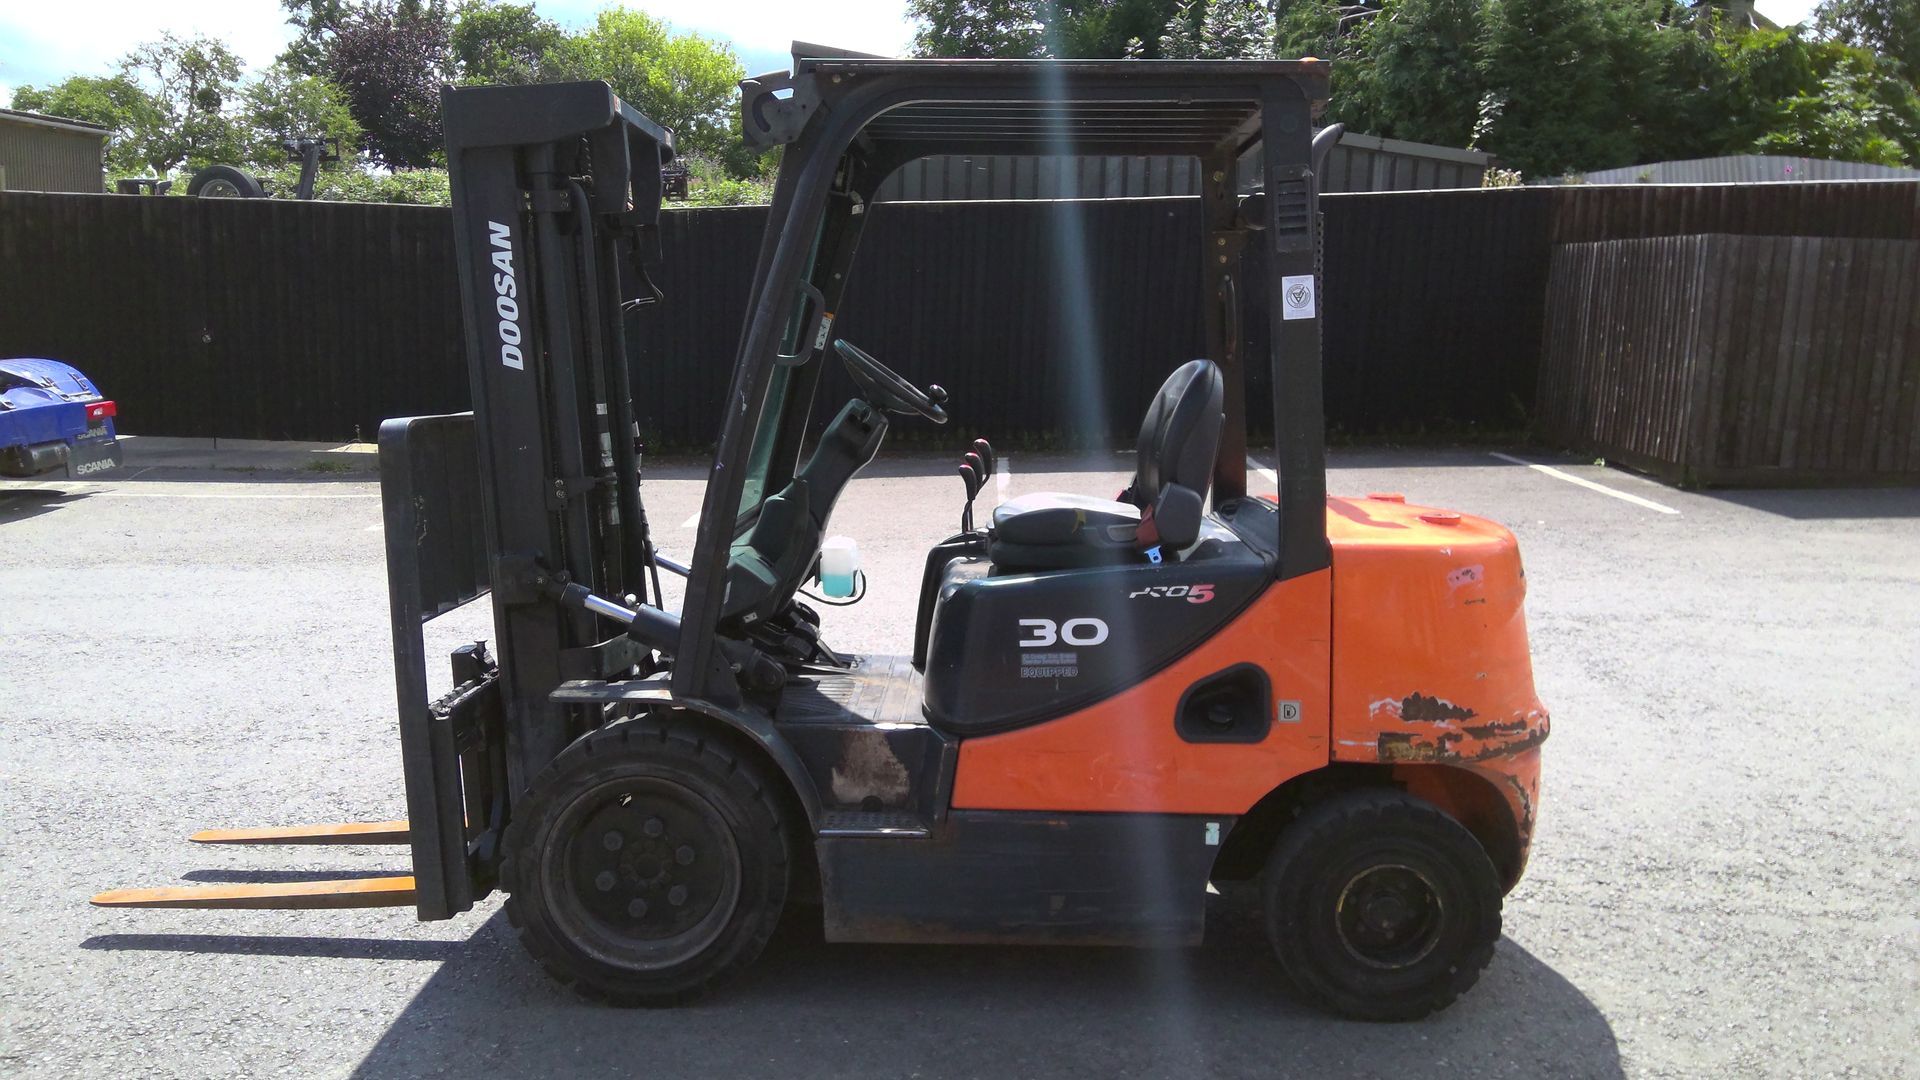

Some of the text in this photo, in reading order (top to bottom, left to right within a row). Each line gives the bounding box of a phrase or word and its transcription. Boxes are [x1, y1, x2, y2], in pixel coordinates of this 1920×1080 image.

[488, 220, 524, 371] DOOSAN
[77, 458, 116, 475] SCANIA
[1019, 618, 1109, 647] 30
[1021, 666, 1079, 678] EQUIPPED
